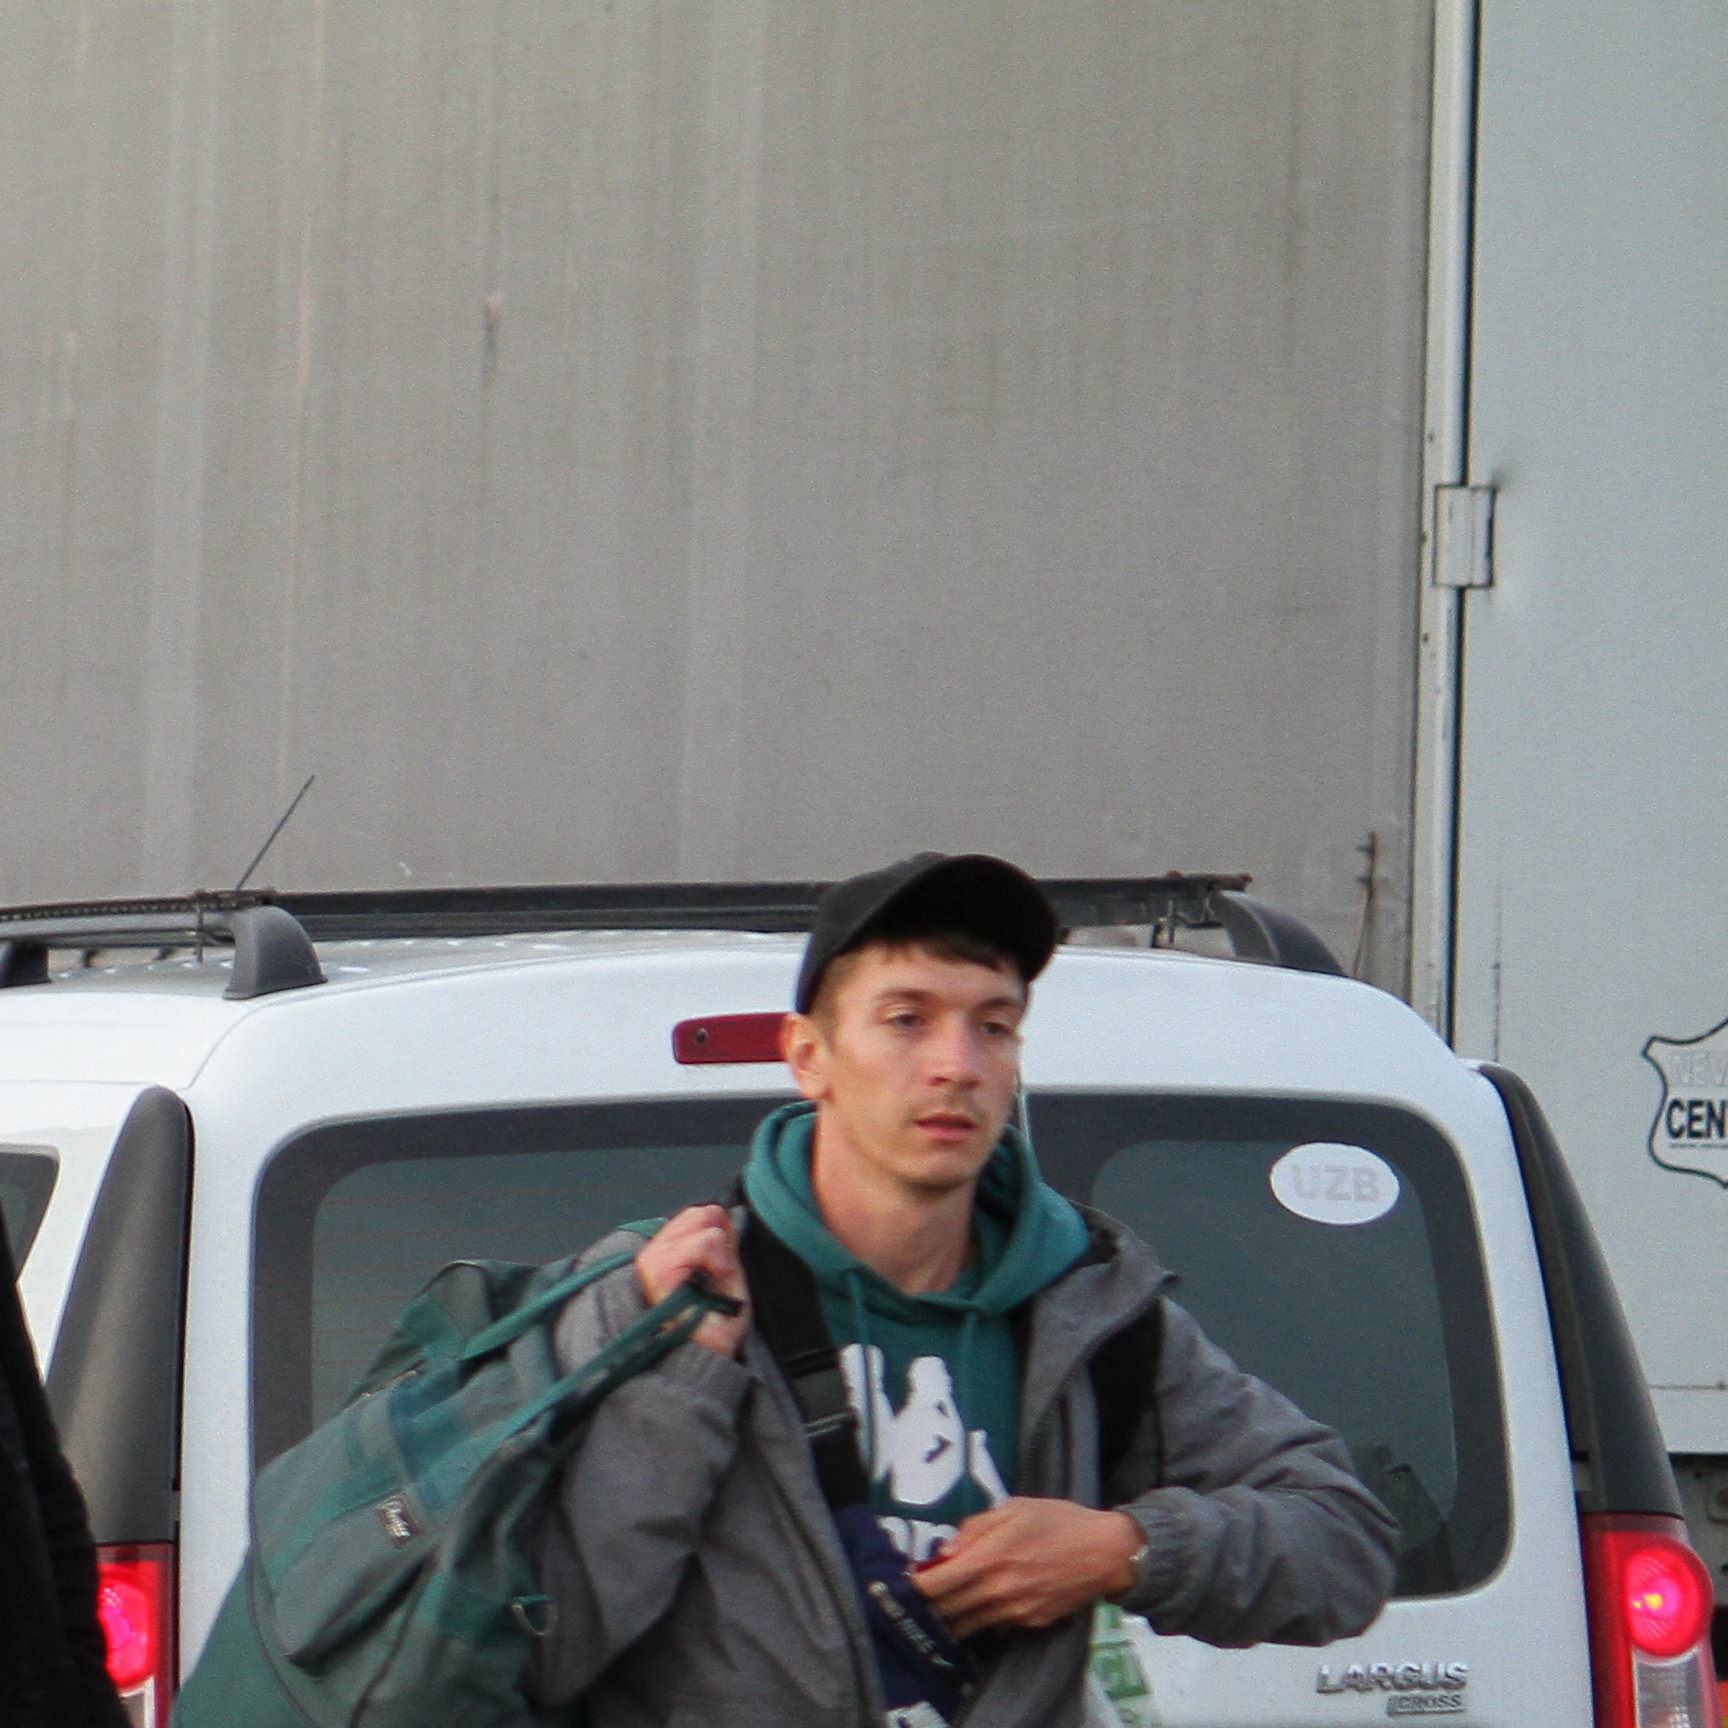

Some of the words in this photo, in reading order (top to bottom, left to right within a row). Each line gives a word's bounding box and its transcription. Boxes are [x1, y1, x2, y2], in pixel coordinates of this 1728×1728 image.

[1665, 1097, 1728, 1141] CEN
[1291, 1165, 1380, 1202] UZB
[1316, 1660, 1470, 1694] LARGUS
[1395, 1693, 1464, 1711] CROSS
